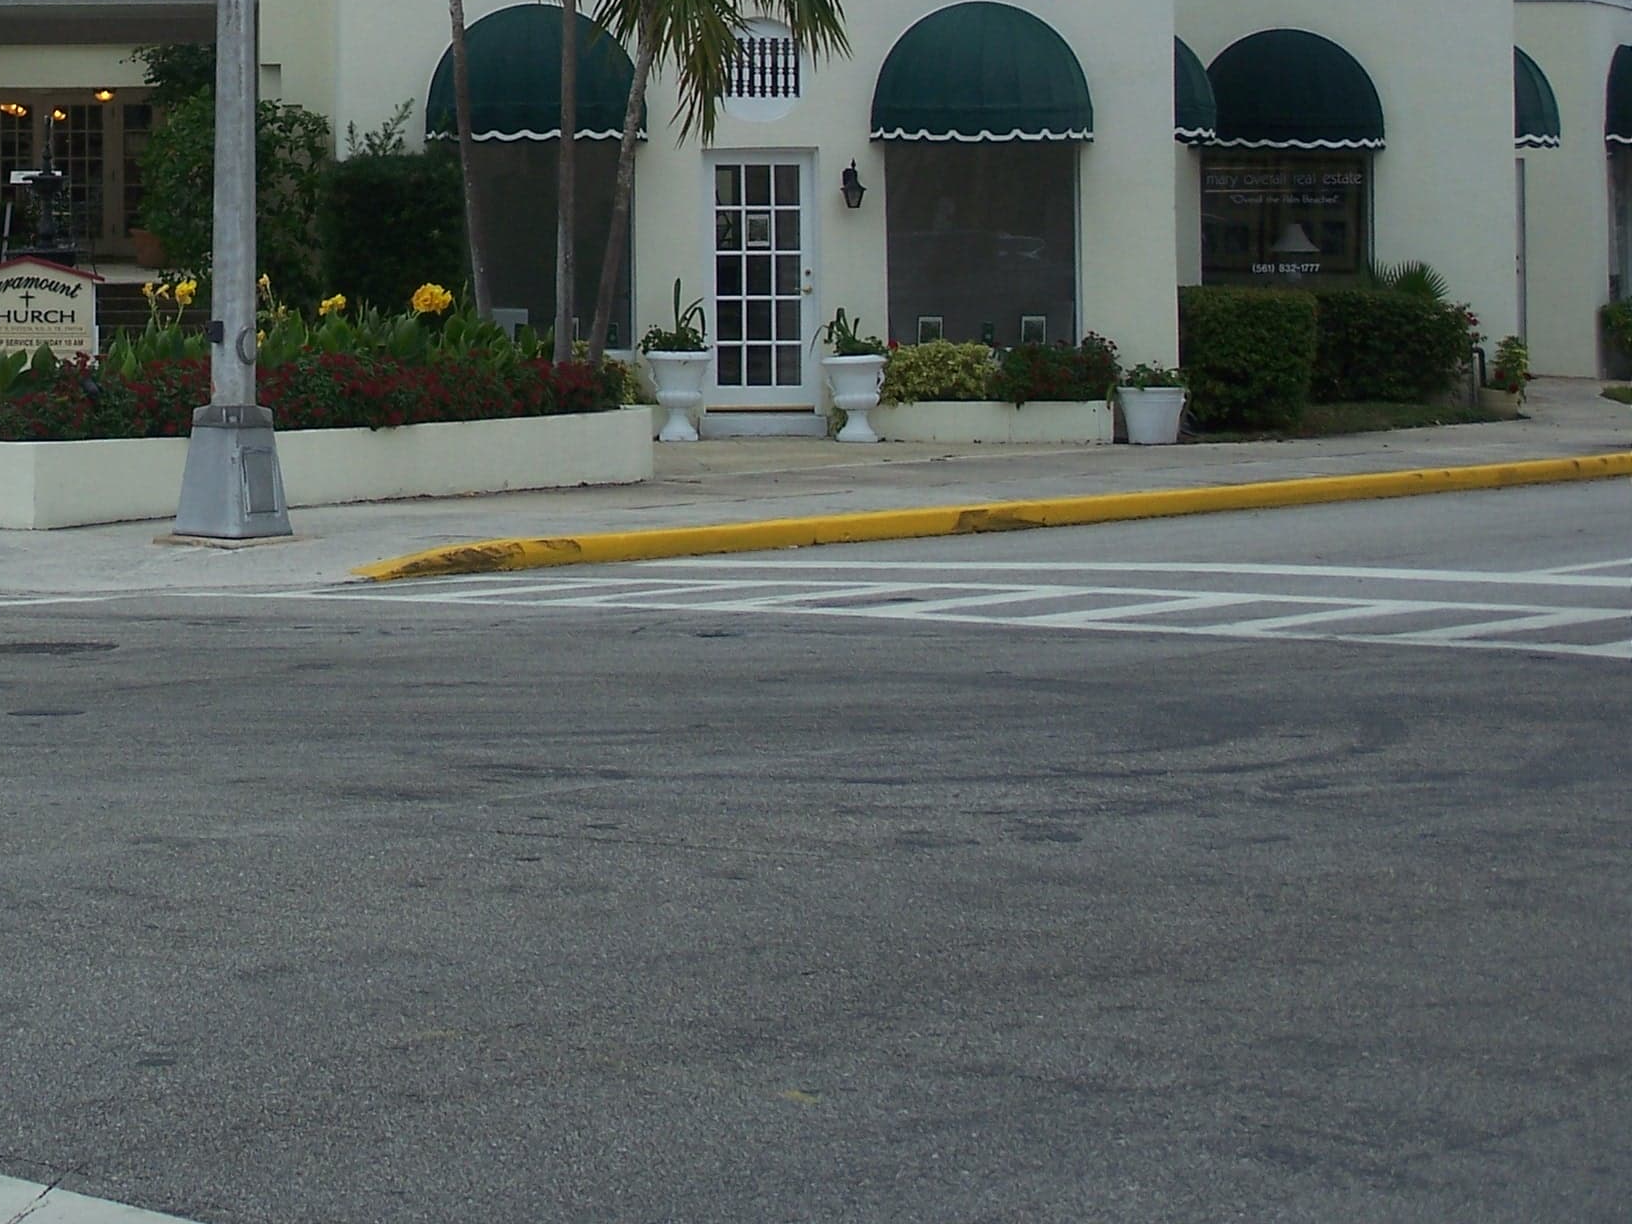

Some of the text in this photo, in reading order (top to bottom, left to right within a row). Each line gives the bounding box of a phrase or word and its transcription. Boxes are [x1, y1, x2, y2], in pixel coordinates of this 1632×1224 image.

[1293, 173, 1317, 185] real
[1322, 173, 1362, 185] estate
[1252, 263, 1275, 273] (561)
